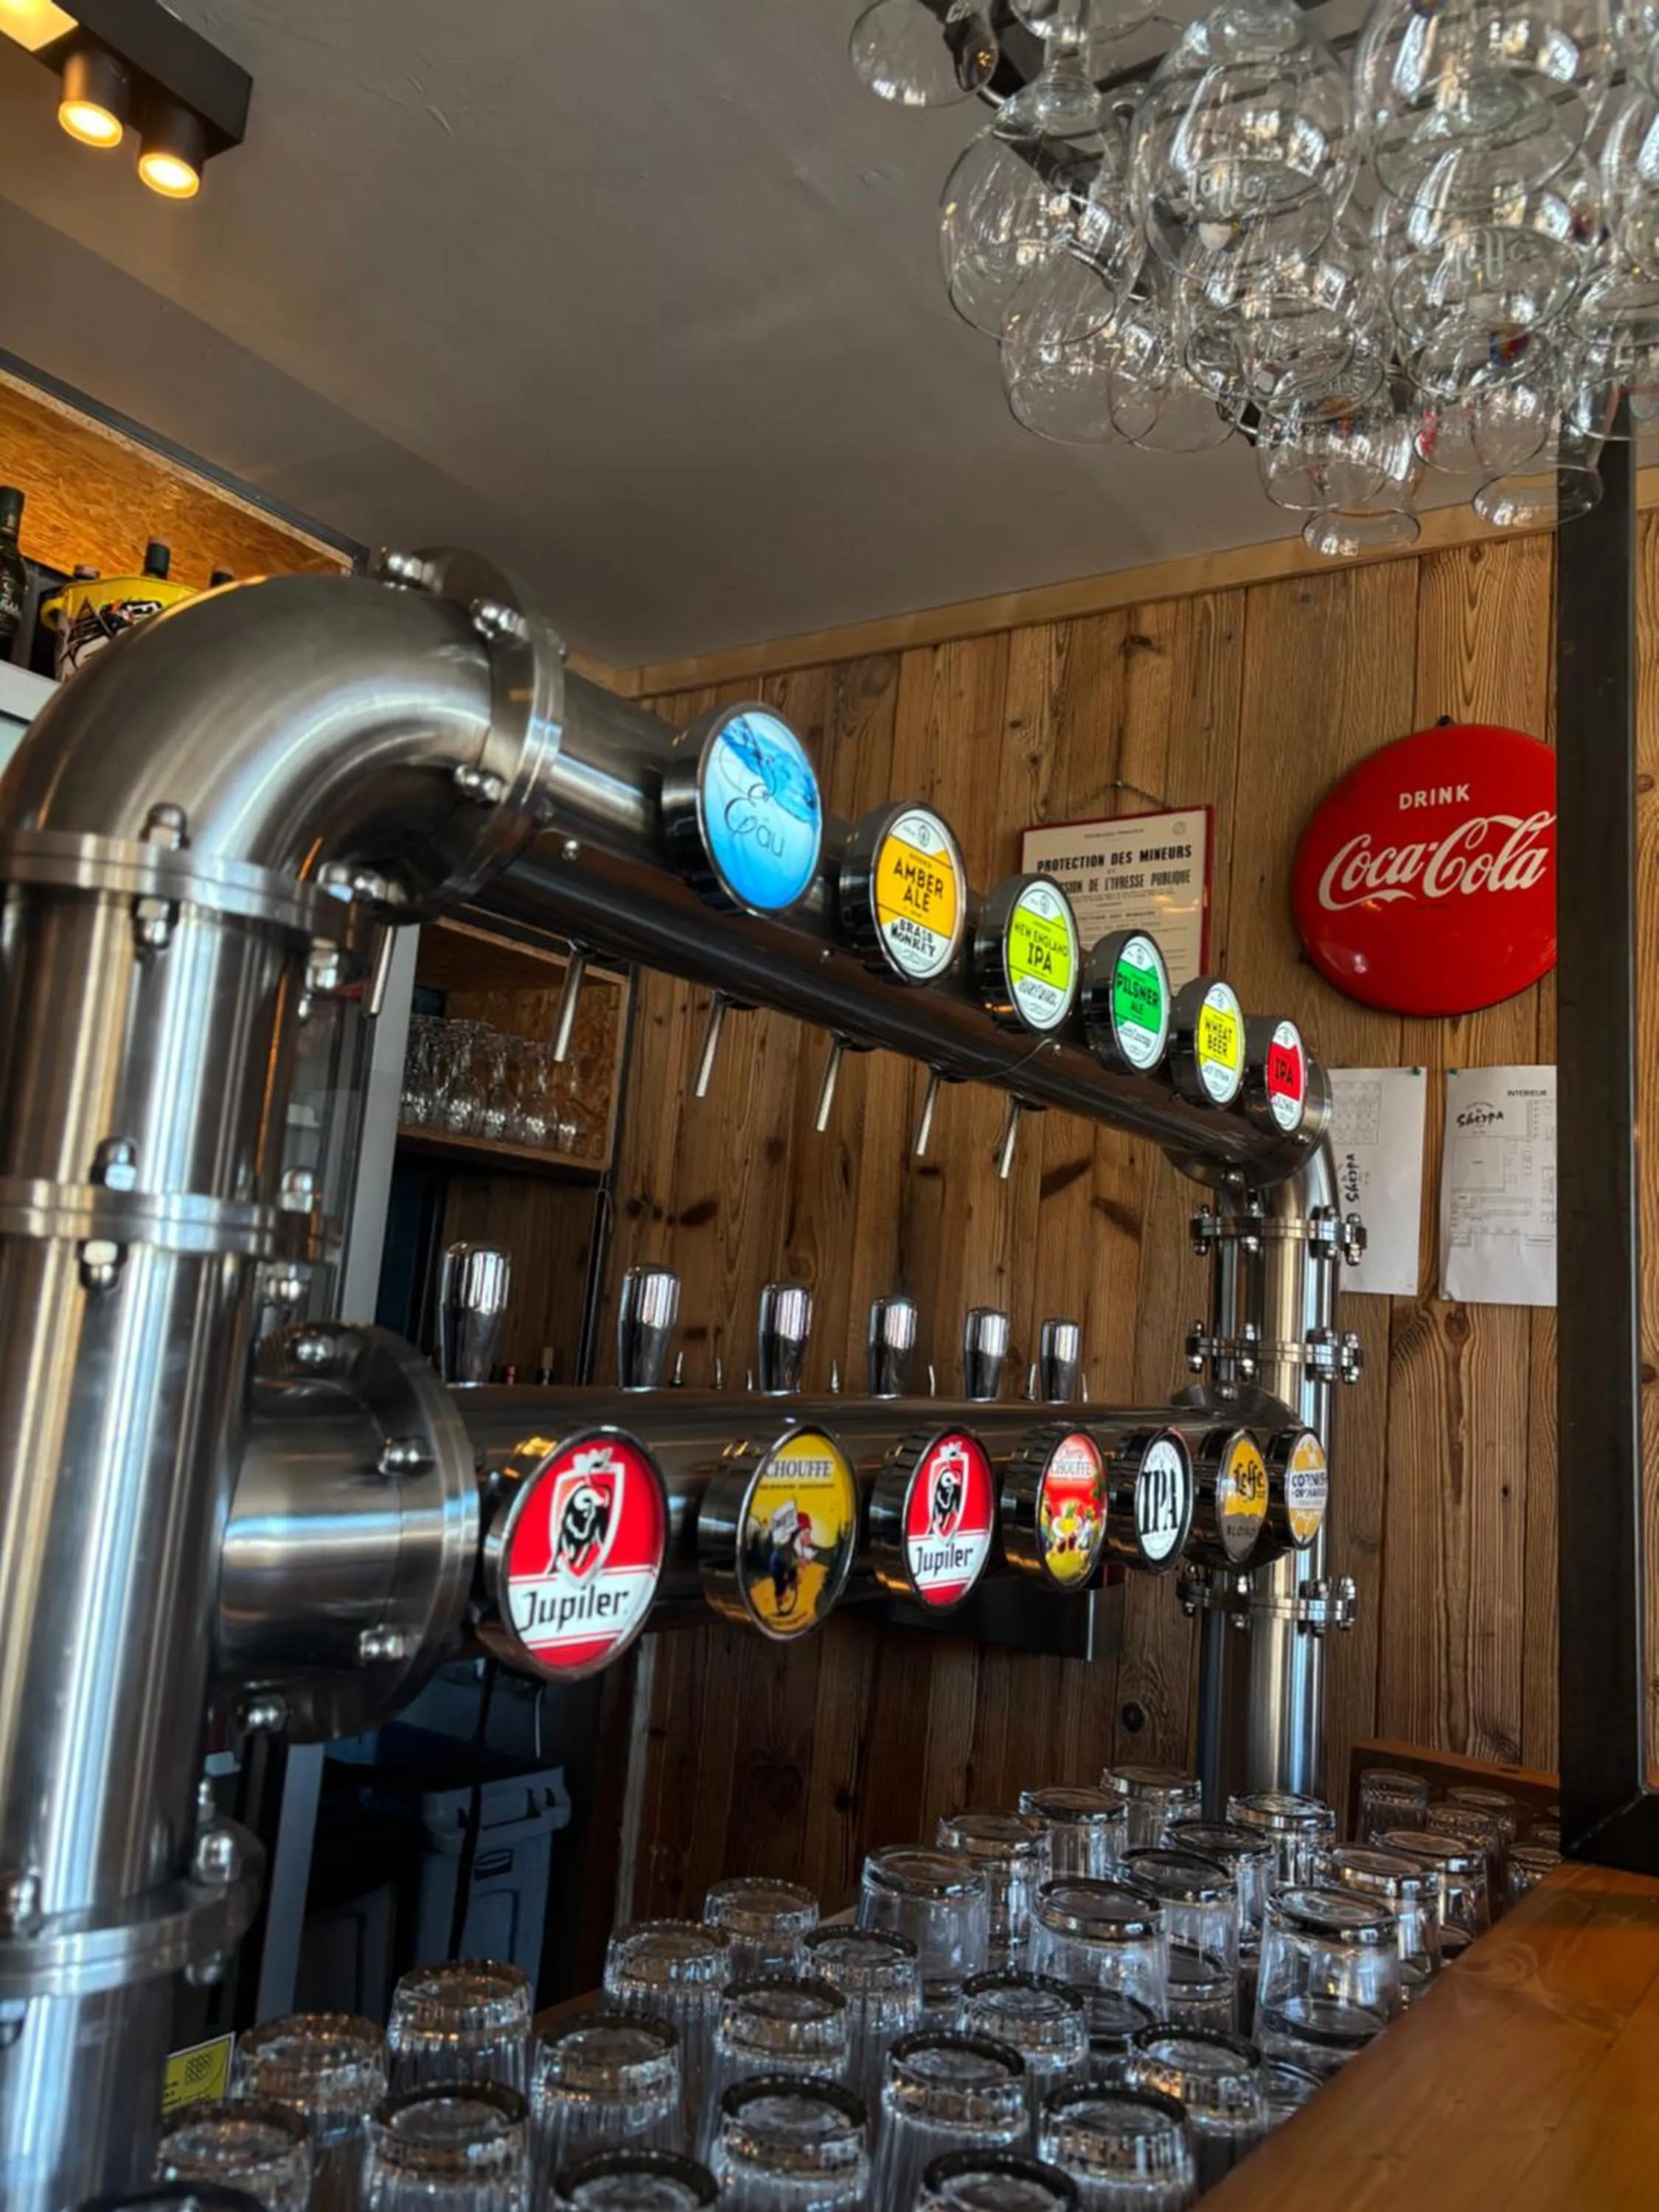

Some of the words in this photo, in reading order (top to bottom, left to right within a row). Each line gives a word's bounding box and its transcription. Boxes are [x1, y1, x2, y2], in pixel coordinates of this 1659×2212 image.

[1399, 783, 1471, 810] DRINK
[724, 782, 786, 858] Eau
[1037, 854, 1105, 872] PROTECTION
[1110, 851, 1133, 866] DES
[1139, 844, 1192, 863] MINEURS
[1318, 810, 1557, 911] Coca-Cola
[893, 856, 944, 900] AMBER
[902, 884, 931, 913] ALE
[1027, 942, 1053, 974] IPA
[1274, 1059, 1294, 1085] IPA
[1141, 1468, 1178, 1537] IPA
[913, 1543, 974, 1578] Jupiler
[518, 1582, 630, 1634] Jupiler
